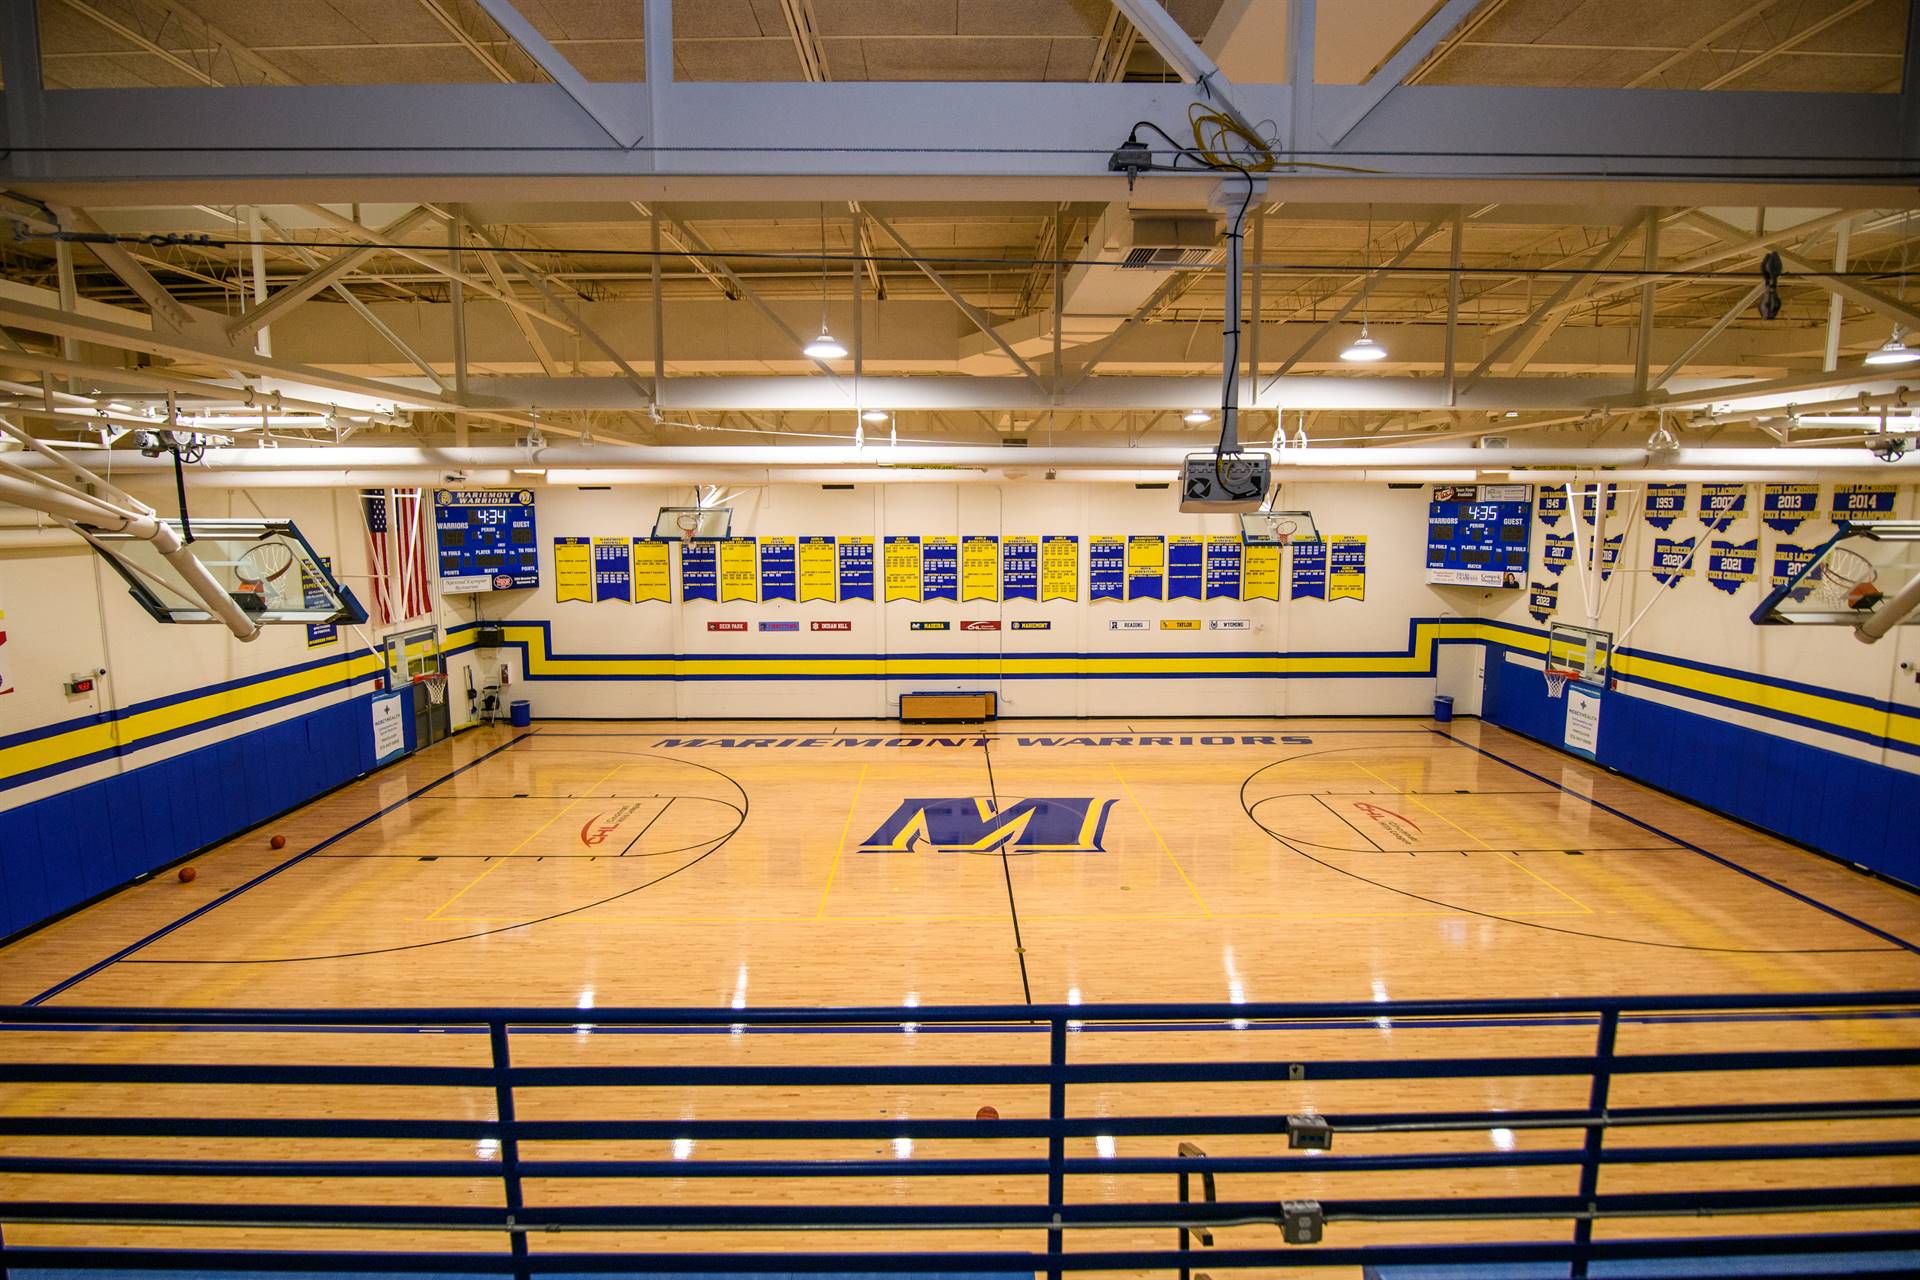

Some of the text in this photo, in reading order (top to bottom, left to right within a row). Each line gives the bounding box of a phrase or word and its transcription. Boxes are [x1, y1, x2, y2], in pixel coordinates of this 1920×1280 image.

[1656, 498, 1674, 508] 1953
[1778, 496, 1802, 508] 2013
[1848, 494, 1876, 508] 2014
[478, 510, 506, 524] 4:34
[1468, 506, 1498, 520] 4:35
[1552, 547, 1565, 557] 2017
[1662, 554, 1682, 566] 2020
[1721, 558, 1742, 571] 2021
[1536, 596, 1550, 606] 2022
[650, 736, 1312, 748] MARIEMONT WARRIORS
